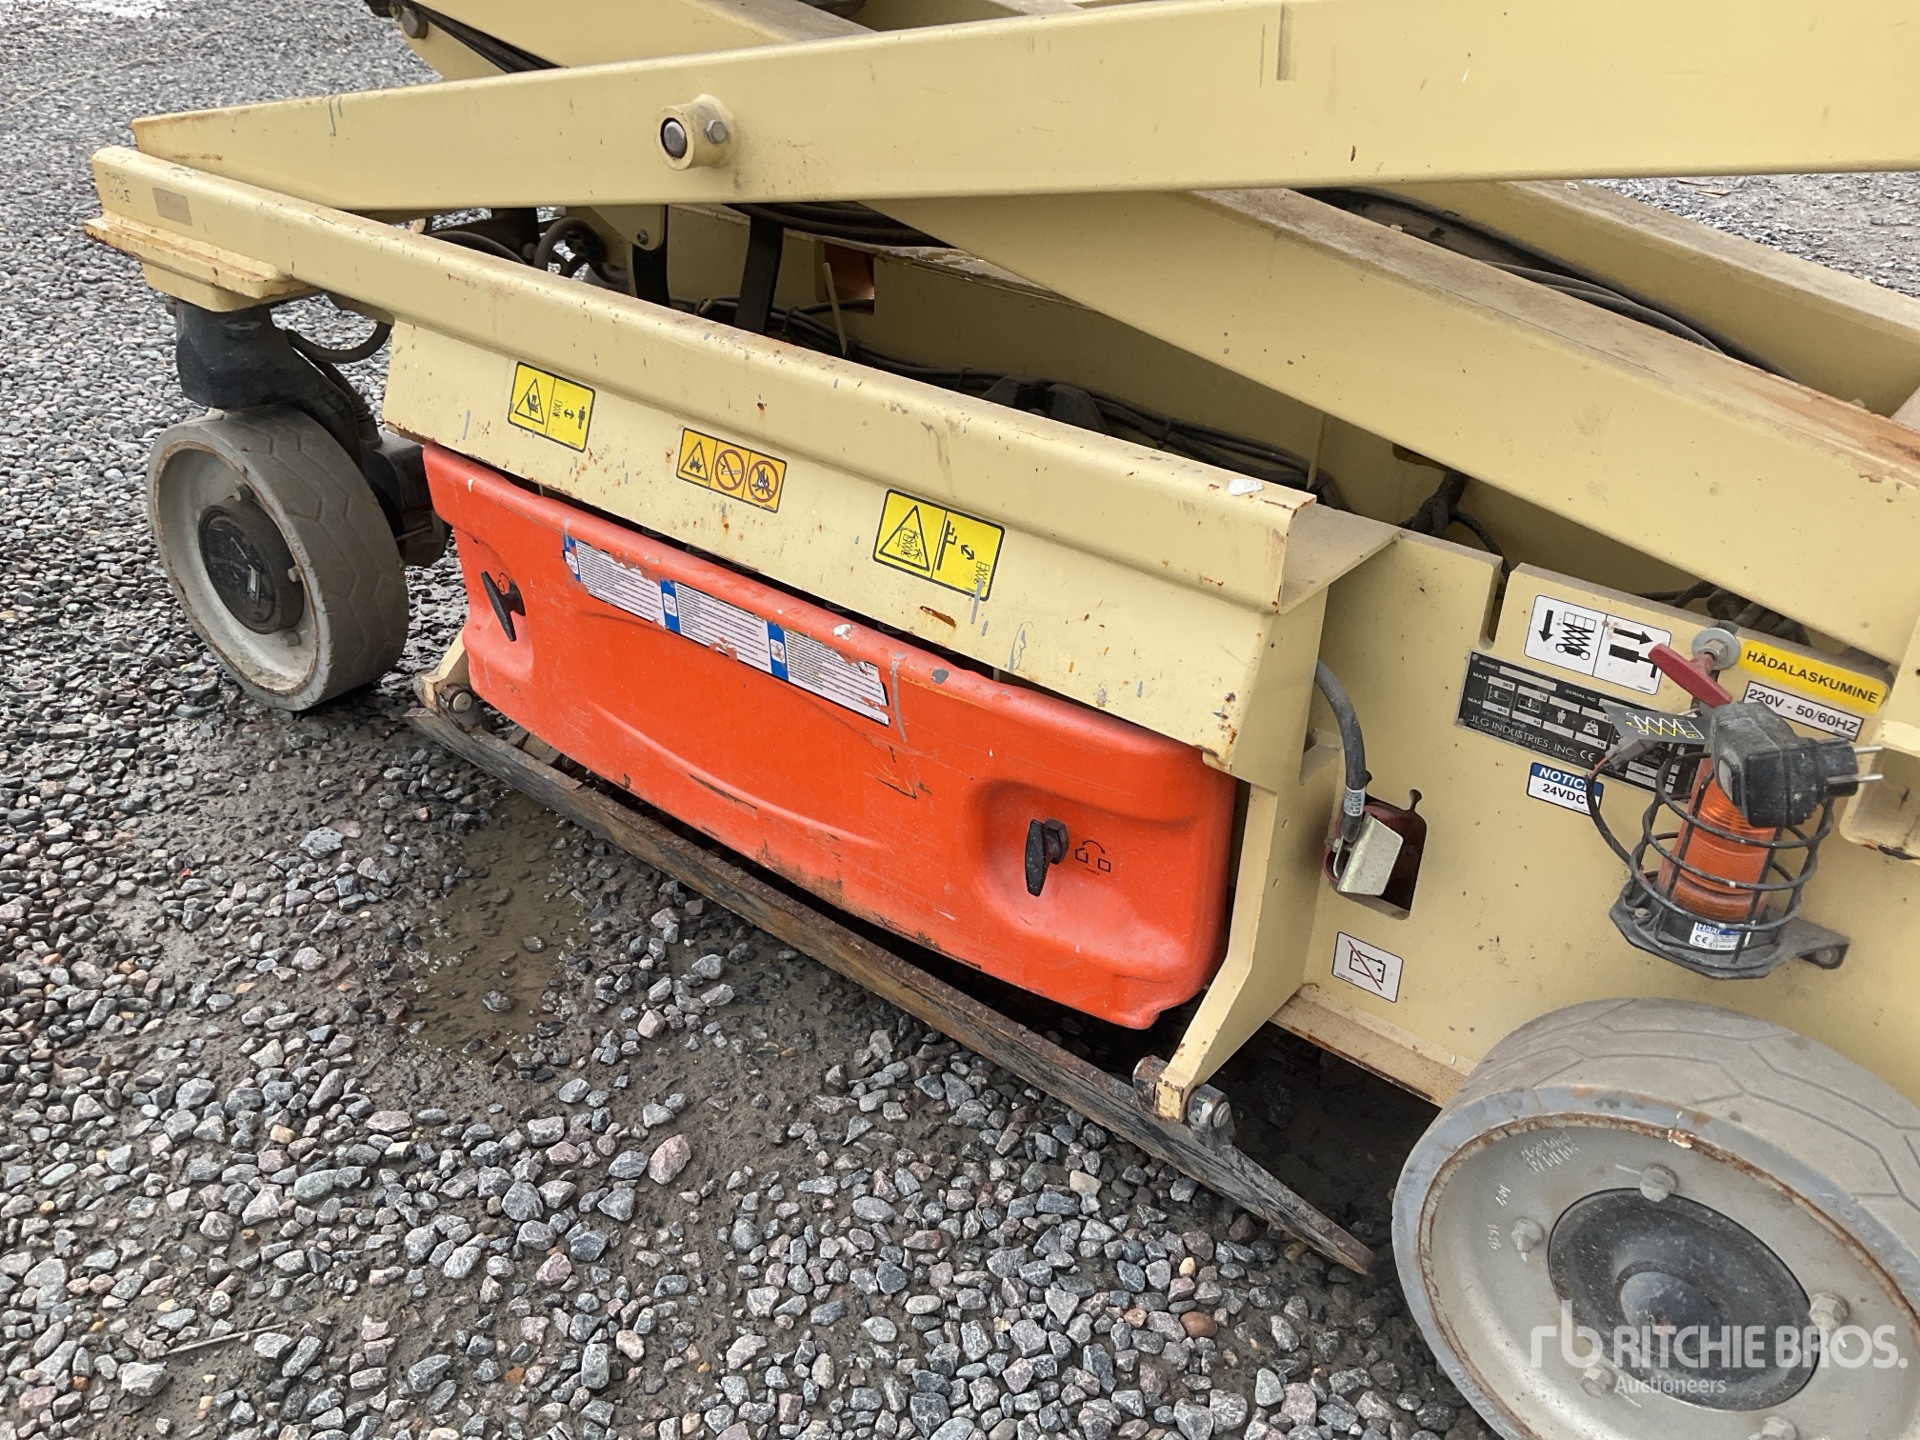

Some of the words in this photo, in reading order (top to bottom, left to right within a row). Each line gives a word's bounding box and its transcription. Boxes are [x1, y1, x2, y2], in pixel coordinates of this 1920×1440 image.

[1472, 671, 1488, 680] MAX
[1746, 650, 1879, 704] HÄDALASKUMINE
[1467, 696, 1482, 706] MAX
[1747, 689, 1785, 708] 220V
[1795, 705, 1859, 734] 50/60HZ
[1469, 715, 1490, 728] JLG
[1553, 743, 1577, 758] INC.
[1542, 783, 1586, 805] 24VDC
